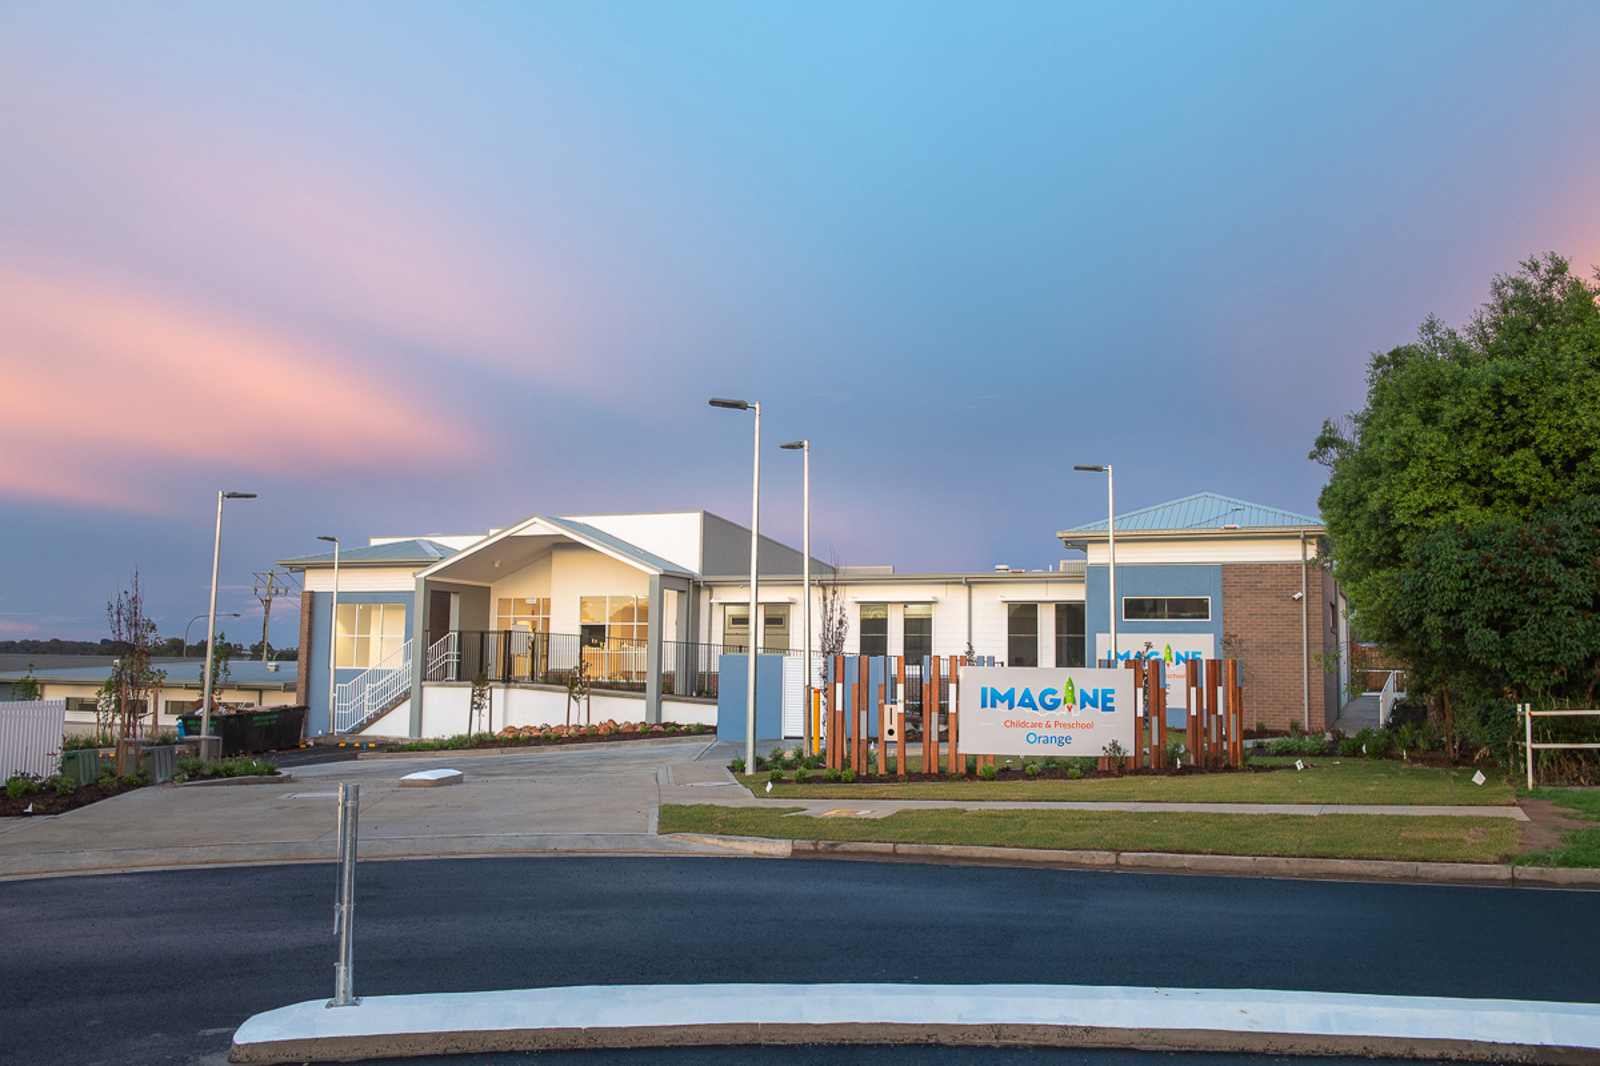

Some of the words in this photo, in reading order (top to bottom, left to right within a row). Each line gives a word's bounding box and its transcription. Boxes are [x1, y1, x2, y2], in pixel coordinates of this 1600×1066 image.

[1003, 719, 1043, 729] Childcare
[1045, 720, 1052, 729] &
[1054, 720, 1094, 730] Preschool
[1026, 732, 1072, 746] Orange
